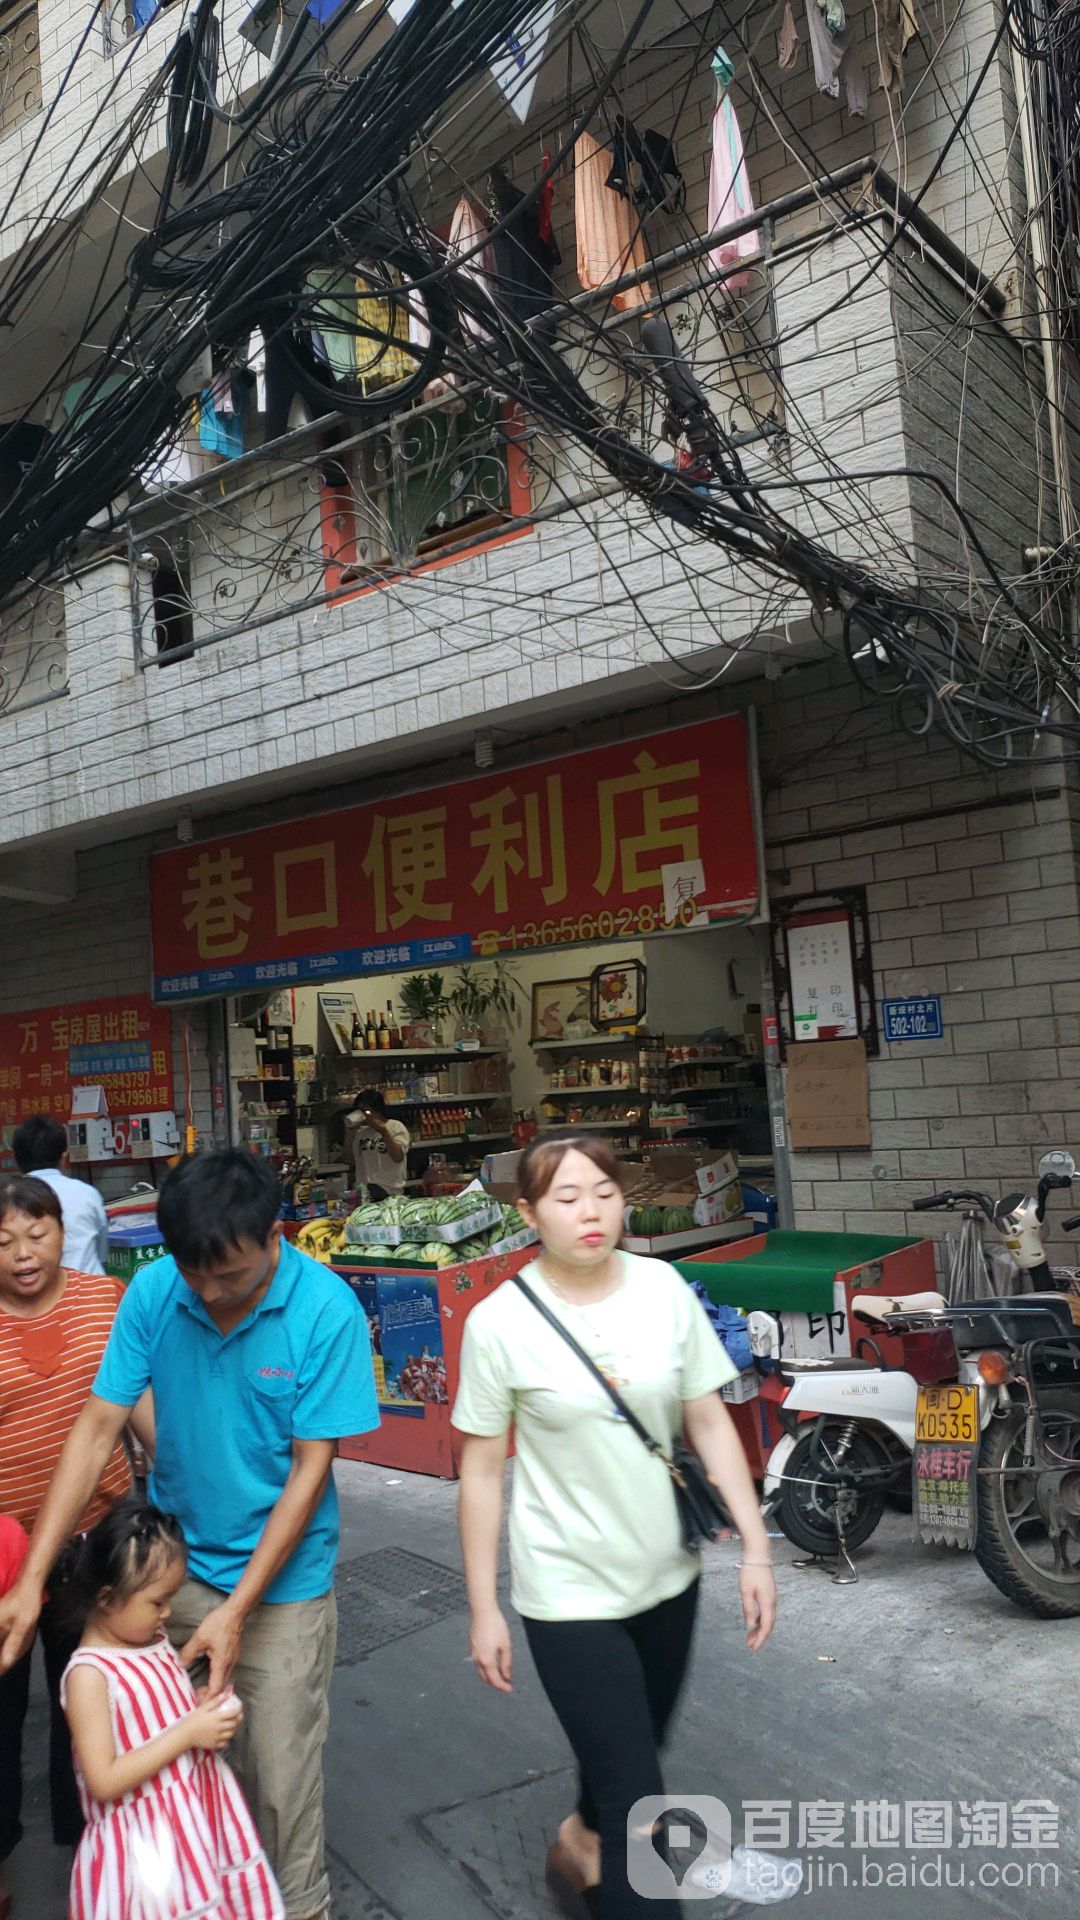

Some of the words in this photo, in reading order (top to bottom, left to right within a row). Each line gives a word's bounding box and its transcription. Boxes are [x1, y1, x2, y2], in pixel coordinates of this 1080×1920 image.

[182, 750, 700, 960] 巷口便利店
[672, 876, 697, 903] 复
[160, 977, 199, 993] 欢迎光临
[256, 961, 298, 979] 欢迎光临
[362, 947, 410, 965] 欢迎光临
[890, 1015, 926, 1035] 502-102
[806, 1311, 846, 1354] 印
